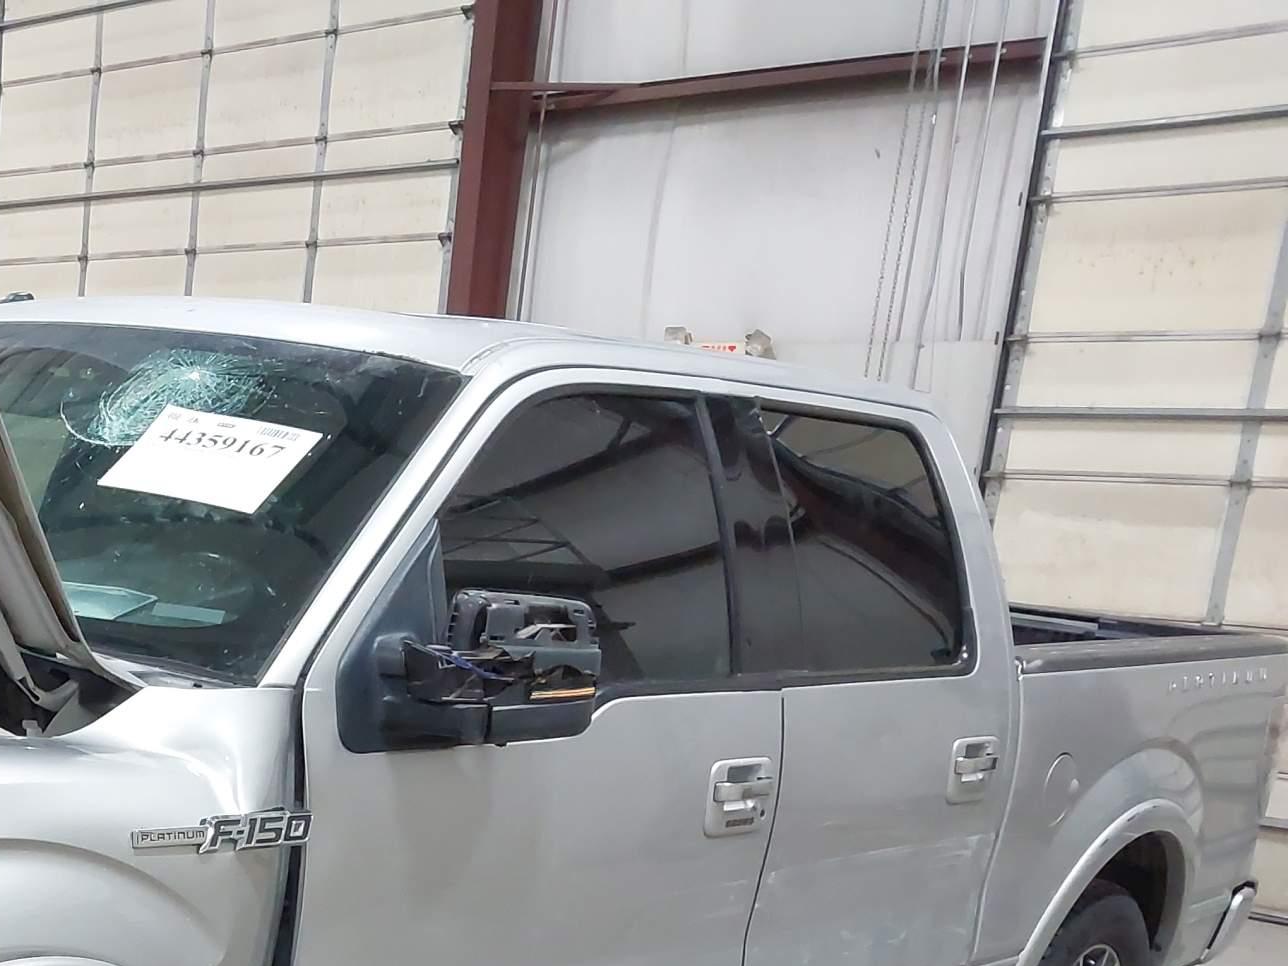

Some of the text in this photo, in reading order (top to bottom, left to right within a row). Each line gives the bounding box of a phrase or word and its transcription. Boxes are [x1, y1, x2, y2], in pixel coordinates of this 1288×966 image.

[160, 428, 287, 459] 44359167
[140, 812, 313, 850] PLATINUM F-150
